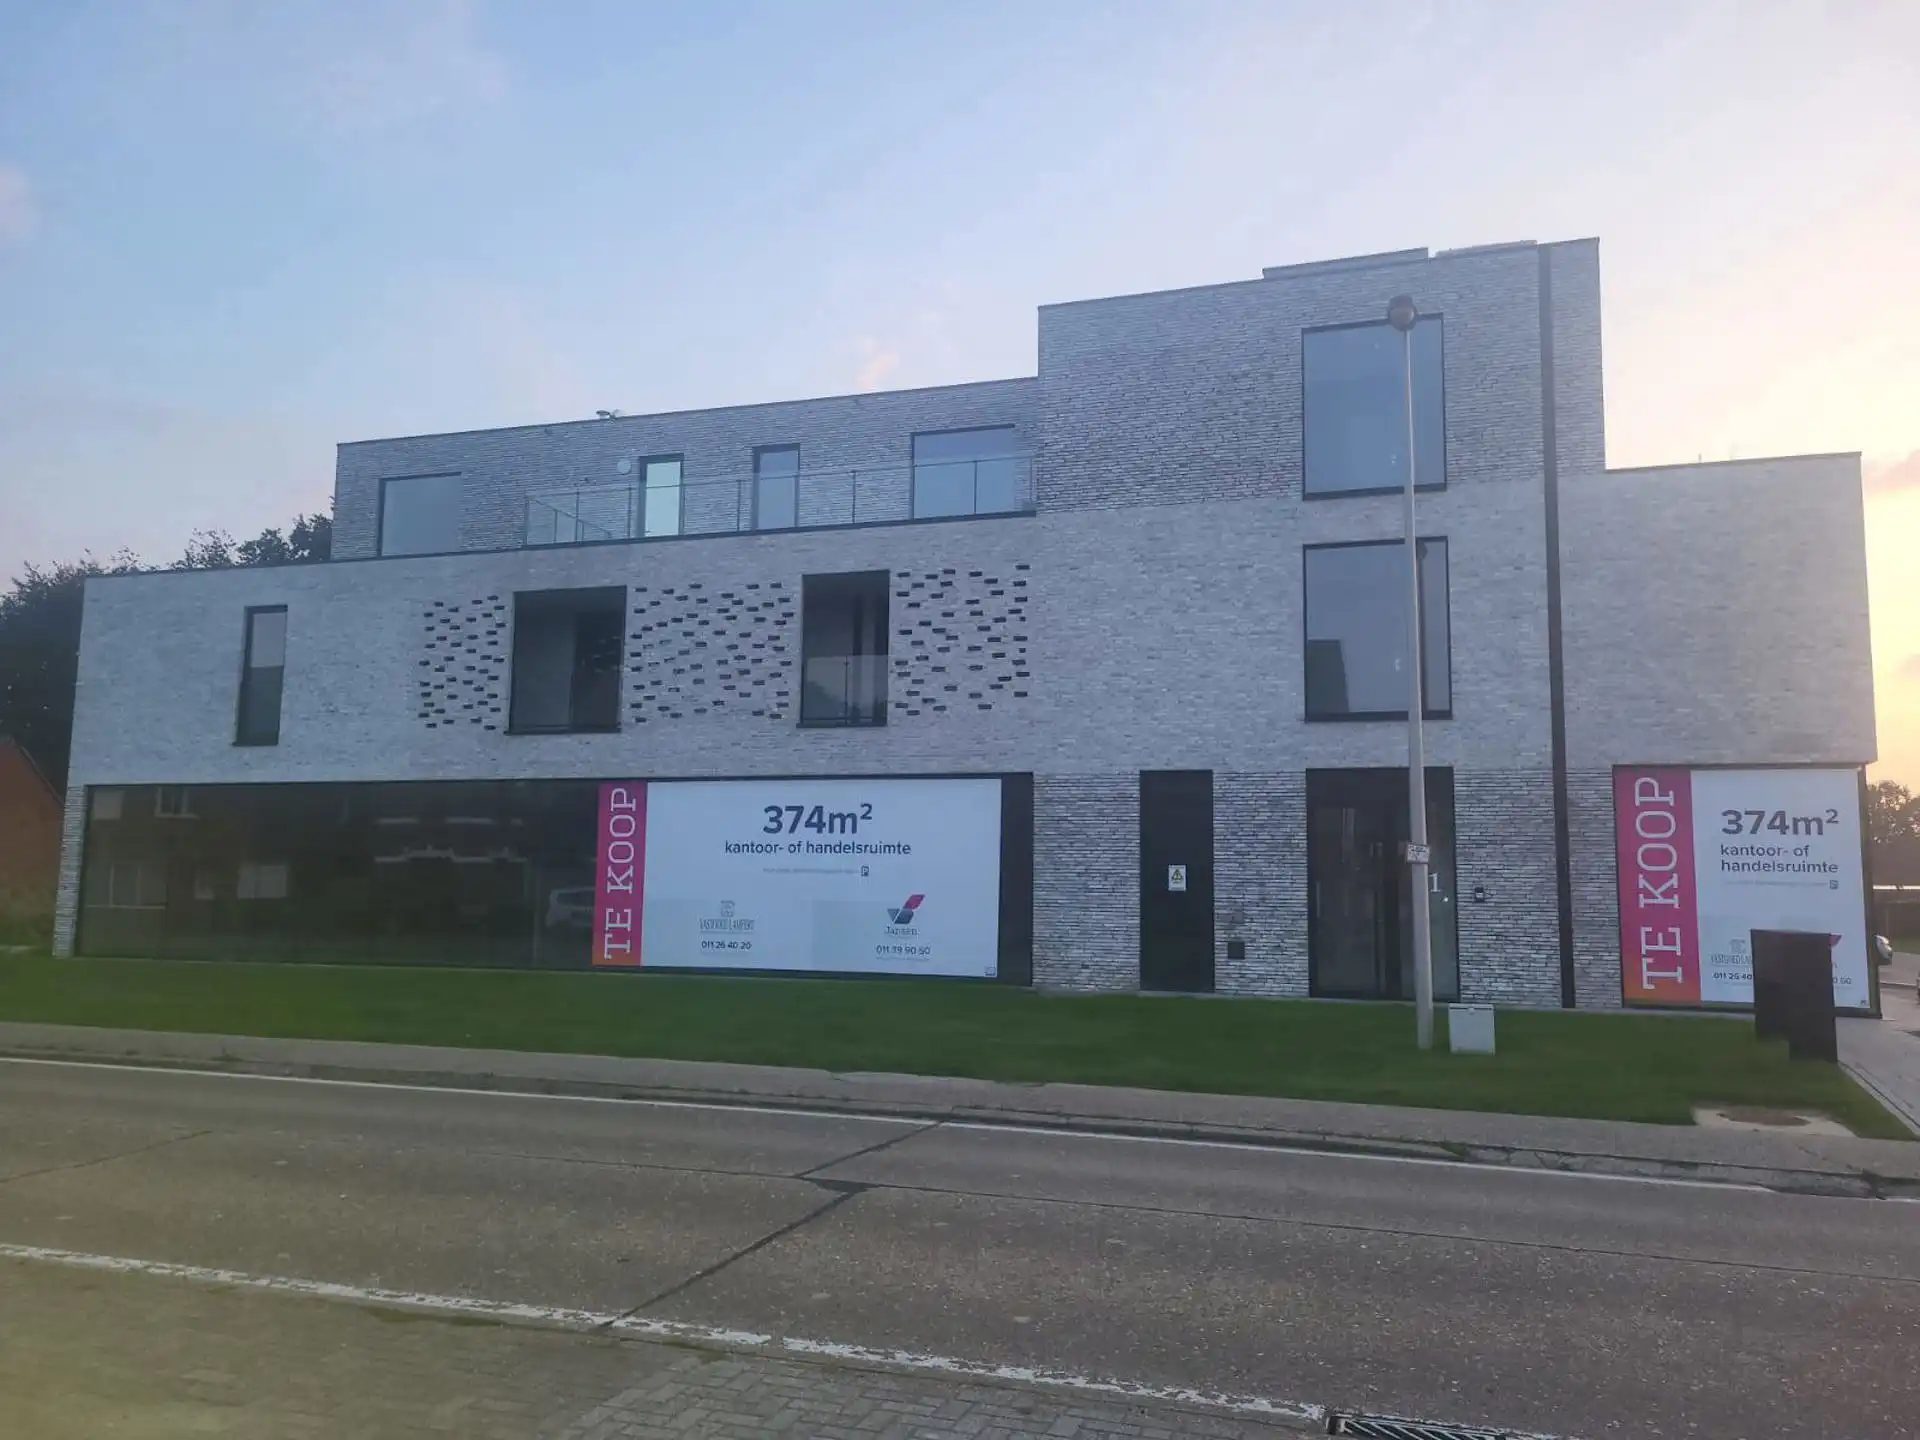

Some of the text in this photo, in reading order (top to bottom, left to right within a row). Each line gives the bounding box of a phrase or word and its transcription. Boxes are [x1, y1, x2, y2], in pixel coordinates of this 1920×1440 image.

[725, 840, 911, 855] kantoor- of handelsruimte
[1720, 844, 1810, 857] kantoor- of
[1721, 860, 1838, 873] handelsruimte
[604, 788, 636, 960] TE KOOP
[1634, 777, 1682, 990] TE KOOP
[727, 940, 739, 949] 40
[740, 941, 752, 950] 20
